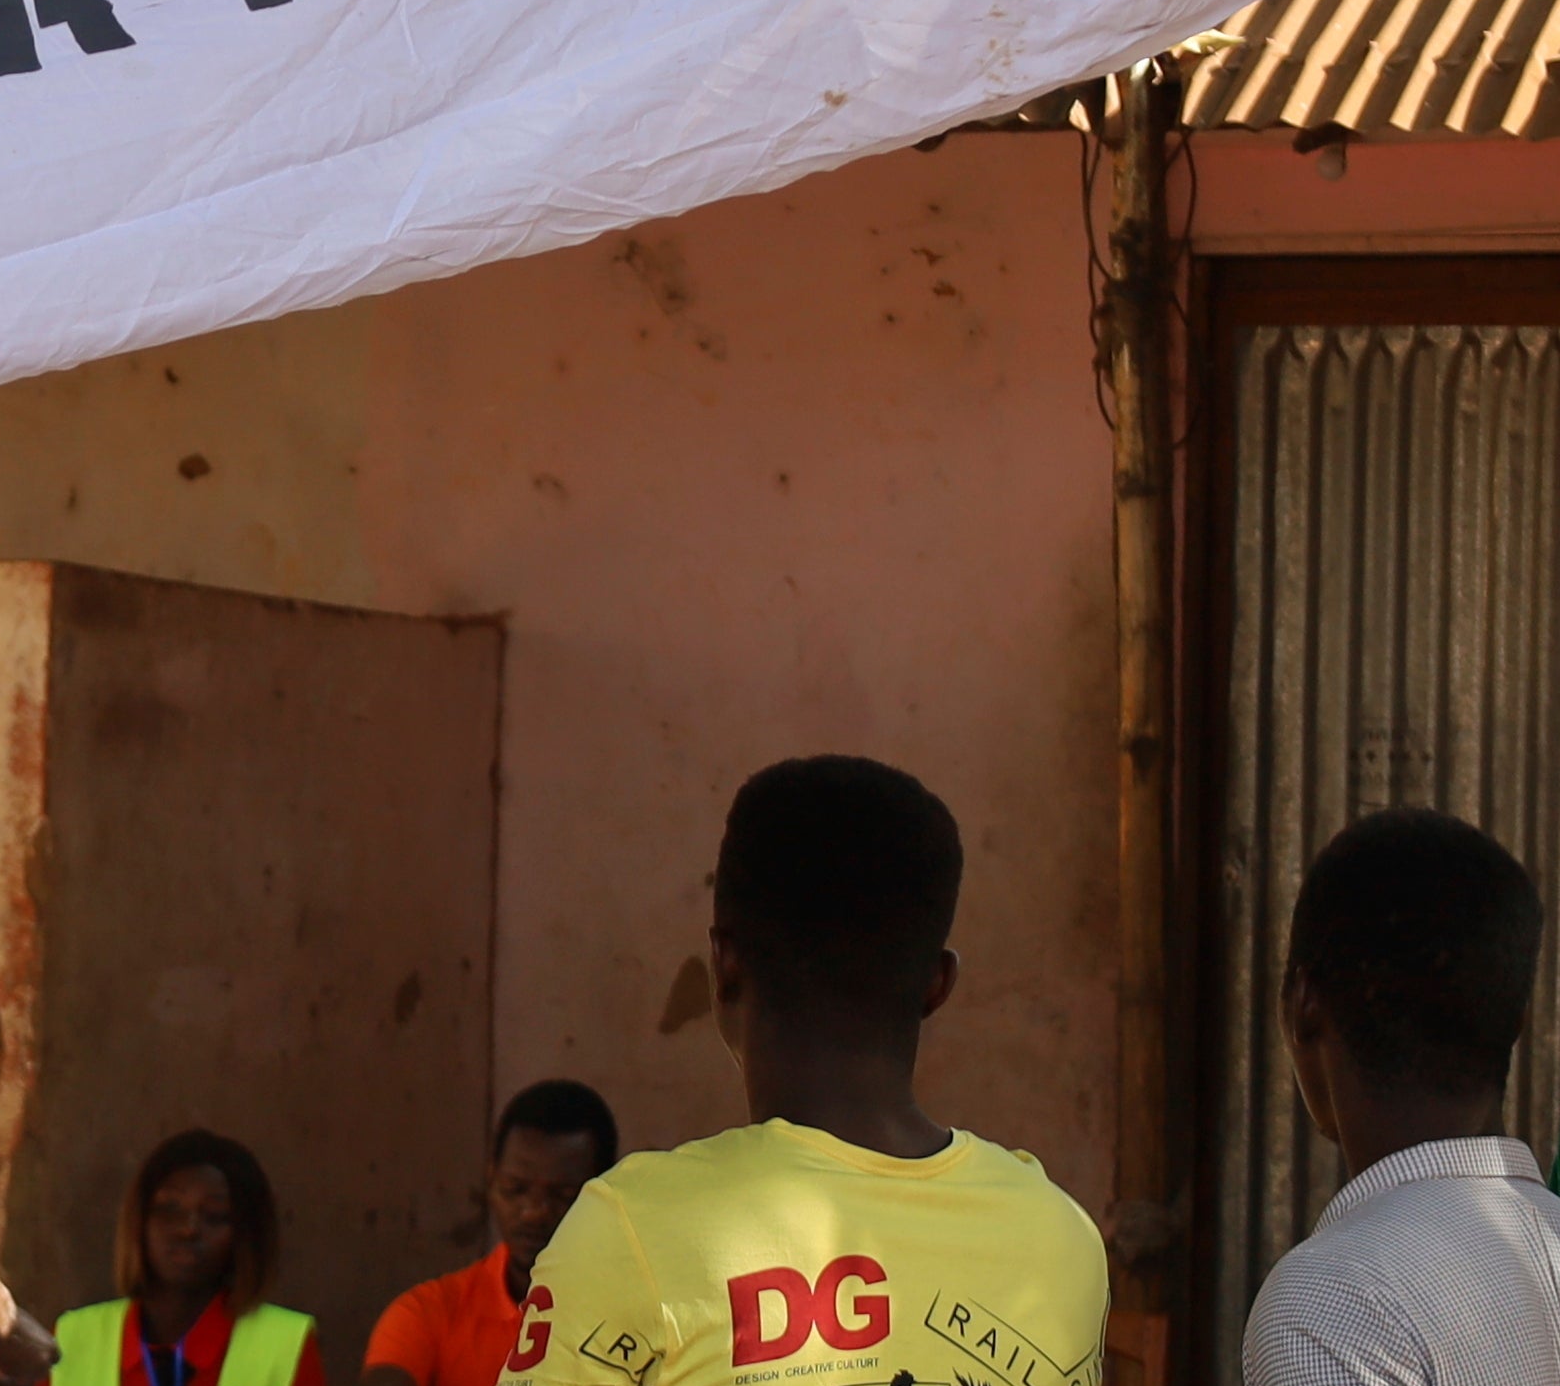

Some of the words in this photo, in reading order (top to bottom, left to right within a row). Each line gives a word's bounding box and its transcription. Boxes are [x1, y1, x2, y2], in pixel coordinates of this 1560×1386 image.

[727, 1254, 890, 1368] DG
[735, 1370, 779, 1386] DESIGN
[785, 1361, 835, 1378] CREATIVE
